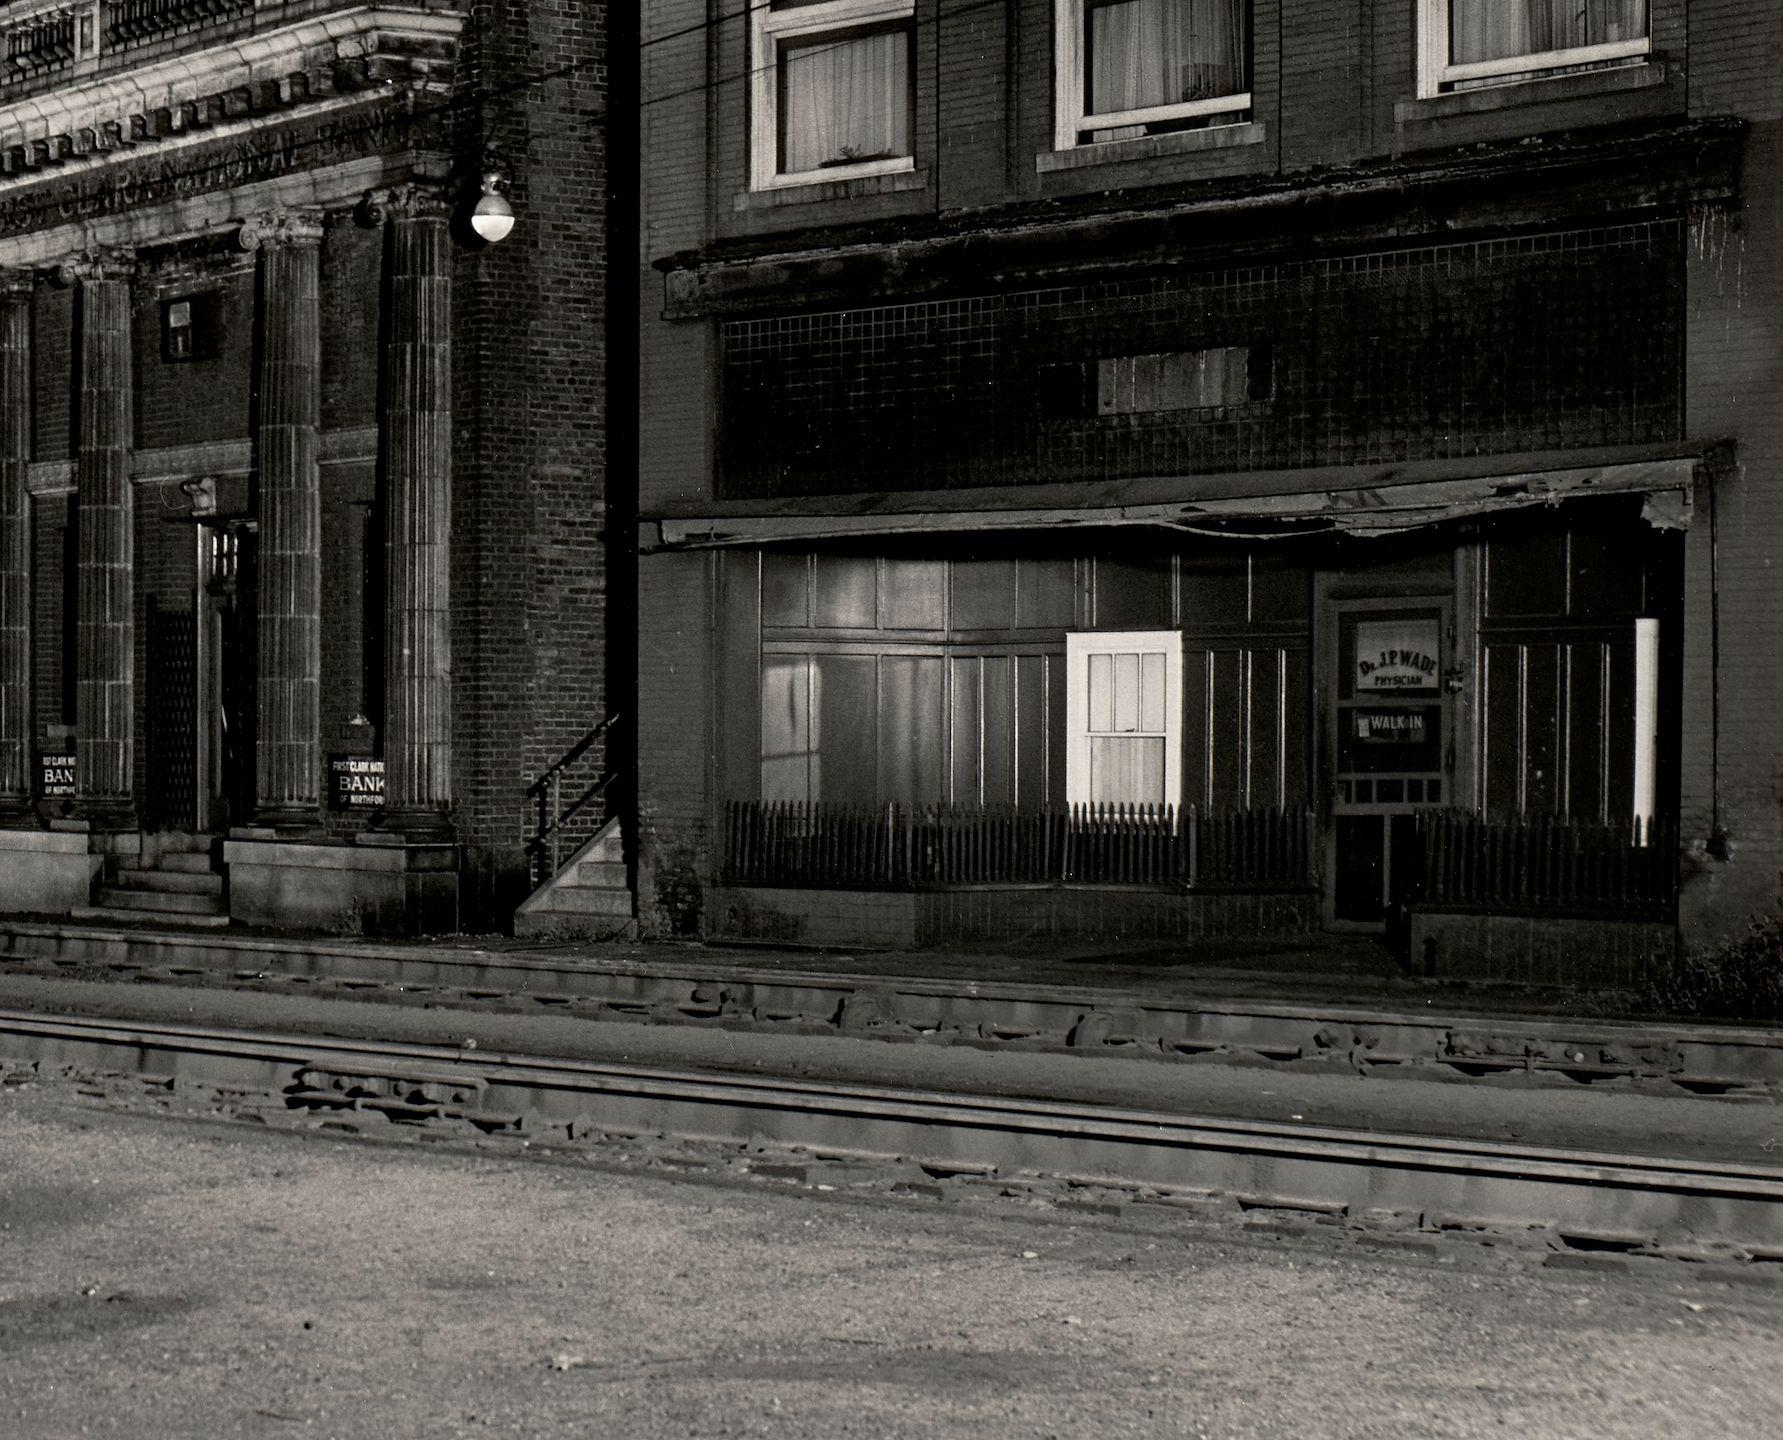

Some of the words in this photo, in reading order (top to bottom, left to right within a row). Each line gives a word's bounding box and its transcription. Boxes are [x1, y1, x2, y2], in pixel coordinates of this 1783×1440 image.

[1400, 650, 1437, 676] WADE
[1375, 675, 1422, 686] PHYSICIAN
[1371, 715, 1405, 730] WALK
[1409, 715, 1423, 730] IN
[52, 756, 67, 766] CLARK
[333, 761, 350, 771] FIRST
[350, 761, 369, 773] CLARK
[44, 769, 73, 783] BAN
[339, 794, 348, 804] OF
